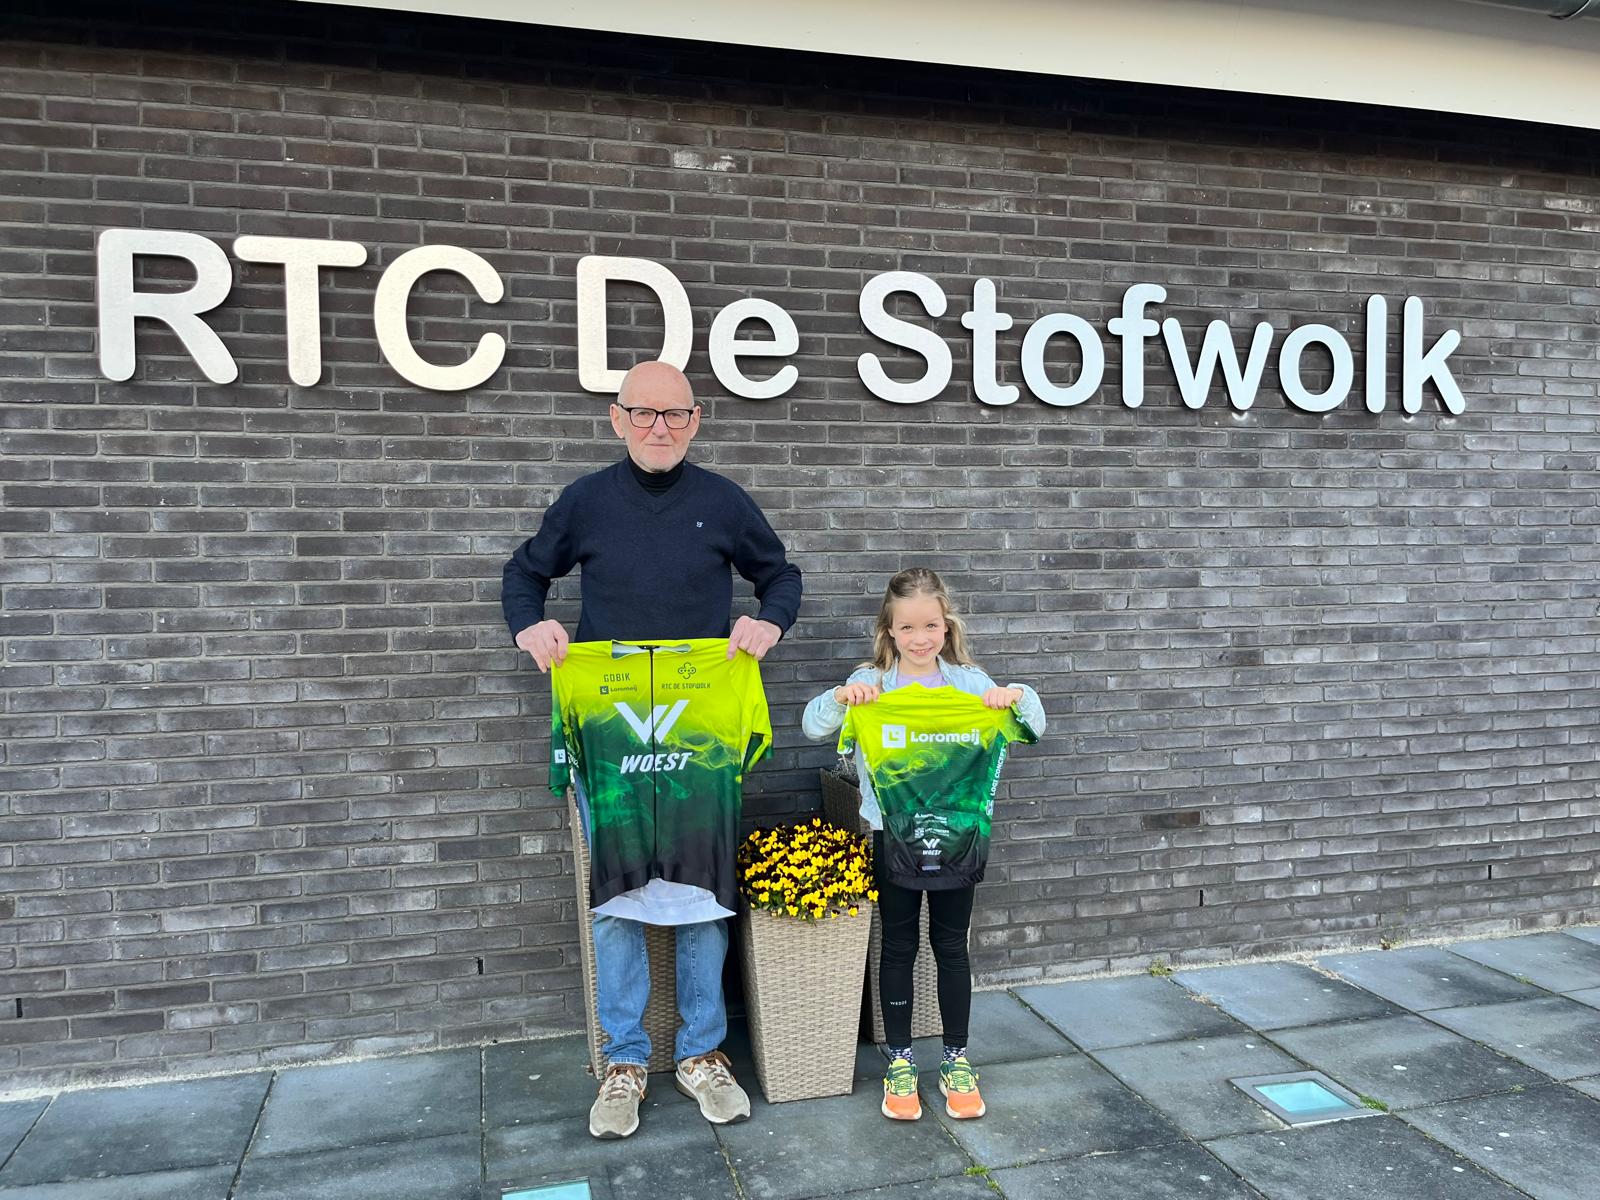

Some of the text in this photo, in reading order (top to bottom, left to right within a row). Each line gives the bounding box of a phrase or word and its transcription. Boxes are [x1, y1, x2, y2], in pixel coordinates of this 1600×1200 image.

[98, 228, 1466, 415] RTC De Stofwolk
[603, 673, 631, 682] GOBIK
[910, 728, 981, 746] Loromeij
[620, 752, 693, 774] WOEST
